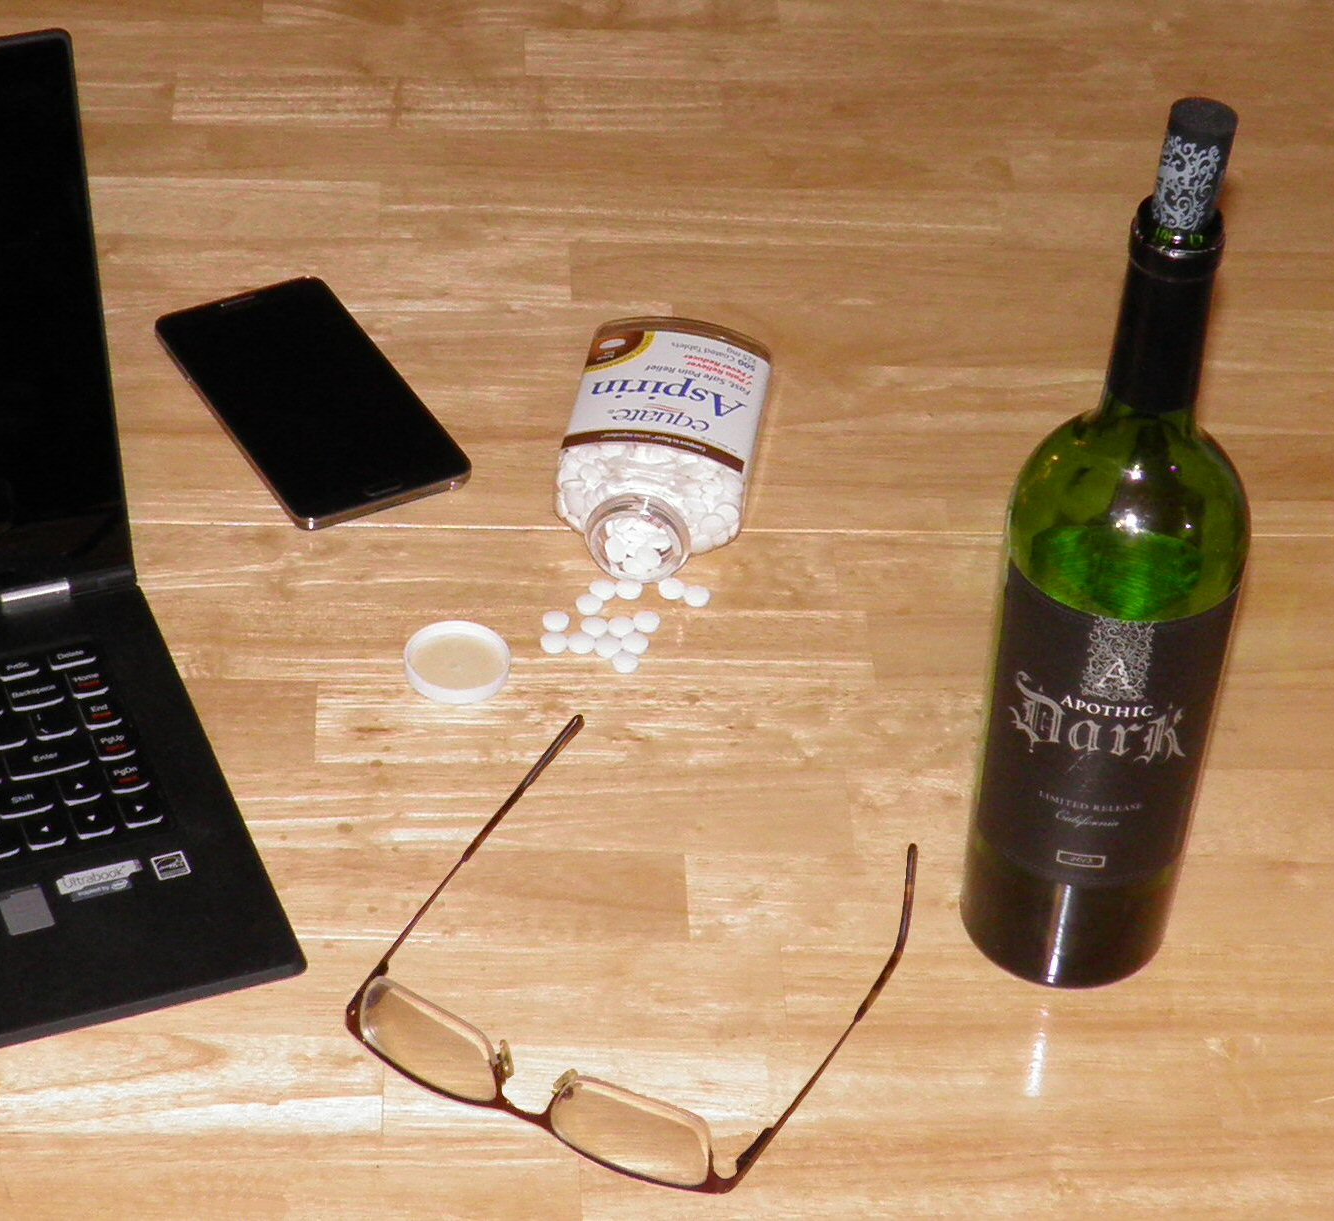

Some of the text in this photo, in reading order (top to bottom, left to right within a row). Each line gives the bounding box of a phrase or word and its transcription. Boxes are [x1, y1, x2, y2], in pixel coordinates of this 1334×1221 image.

[671, 341, 755, 371] 500 Coated Tablets
[684, 354, 721, 366] Reducer
[645, 364, 676, 373] Relief
[678, 367, 701, 378] Pain
[687, 361, 744, 383] Pain Reliever
[703, 373, 725, 385] Safe
[591, 378, 747, 417] Aspirin
[612, 408, 710, 433] equate
[73, 672, 100, 682] Home
[1097, 657, 1133, 689] A
[11, 684, 57, 699] Backspace
[90, 704, 109, 712] End
[1061, 694, 1154, 718] APOTHIC
[100, 734, 125, 744] PgUp
[32, 752, 58, 762] Enter
[113, 766, 138, 776] PgDn
[11, 793, 35, 804] Shift
[1038, 790, 1141, 812] LIMITED RELEASE
[1055, 810, 1120, 828] California
[62, 866, 125, 888] Ultrabook
